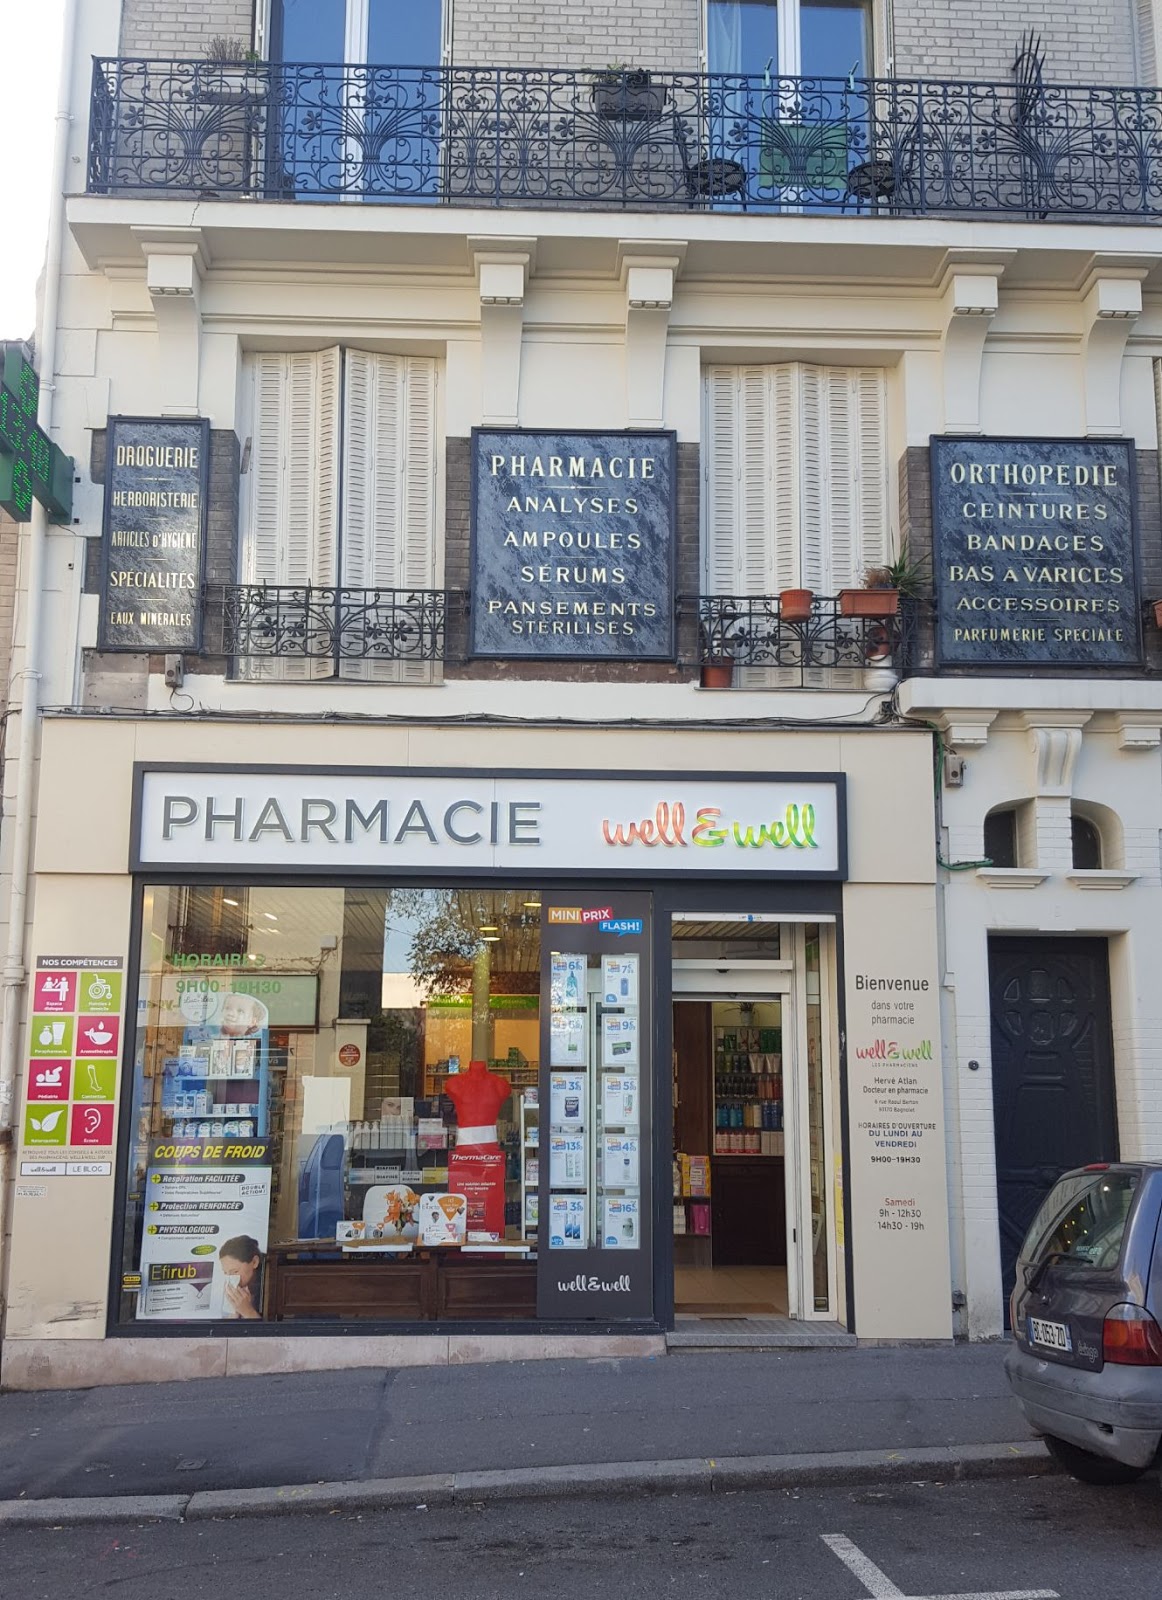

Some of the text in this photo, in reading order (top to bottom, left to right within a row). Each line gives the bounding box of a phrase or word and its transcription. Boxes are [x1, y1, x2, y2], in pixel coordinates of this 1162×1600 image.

[116, 445, 198, 468] DROGUERIE
[491, 455, 655, 479] PHARMACIE
[112, 490, 198, 508] HERBORISTERIE
[506, 496, 638, 514] ANALYSES
[963, 502, 1108, 520] CEINTURES
[112, 530, 150, 548] ARTICLES
[504, 531, 641, 549] AMPOULES
[968, 534, 1104, 551] BANDAGES
[110, 568, 195, 589] SPÉCIALITÉS
[521, 564, 625, 584] SÉRUMS
[950, 566, 994, 582] BAS
[1023, 566, 1123, 583] VARICES
[488, 600, 656, 616] PANSEMENTS
[956, 598, 1120, 612] ACCESSOIRES
[111, 612, 134, 624] EAUX
[954, 628, 1045, 642] PARFUMERIE
[162, 795, 542, 846] PHARMACIE
[551, 909, 610, 922] MINI PRIX
[602, 922, 640, 931] FLASH!
[855, 974, 929, 991] Bienvenue
[871, 1001, 914, 1010] dans votre
[871, 1015, 915, 1026] pharmacie
[897, 1086, 928, 1095] pharmacie
[154, 1146, 200, 1158] COUPS
[202, 1146, 222, 1158] DE
[162, 1175, 203, 1184] Respiration
[885, 1198, 915, 1206] Samedi
[879, 1209, 889, 1217] 9h
[897, 1209, 922, 1217] 12h30
[877, 1221, 903, 1230] 14h30
[911, 1222, 924, 1230] 19h
[152, 1264, 197, 1280] Efirub
[557, 1274, 631, 1292] well&well
